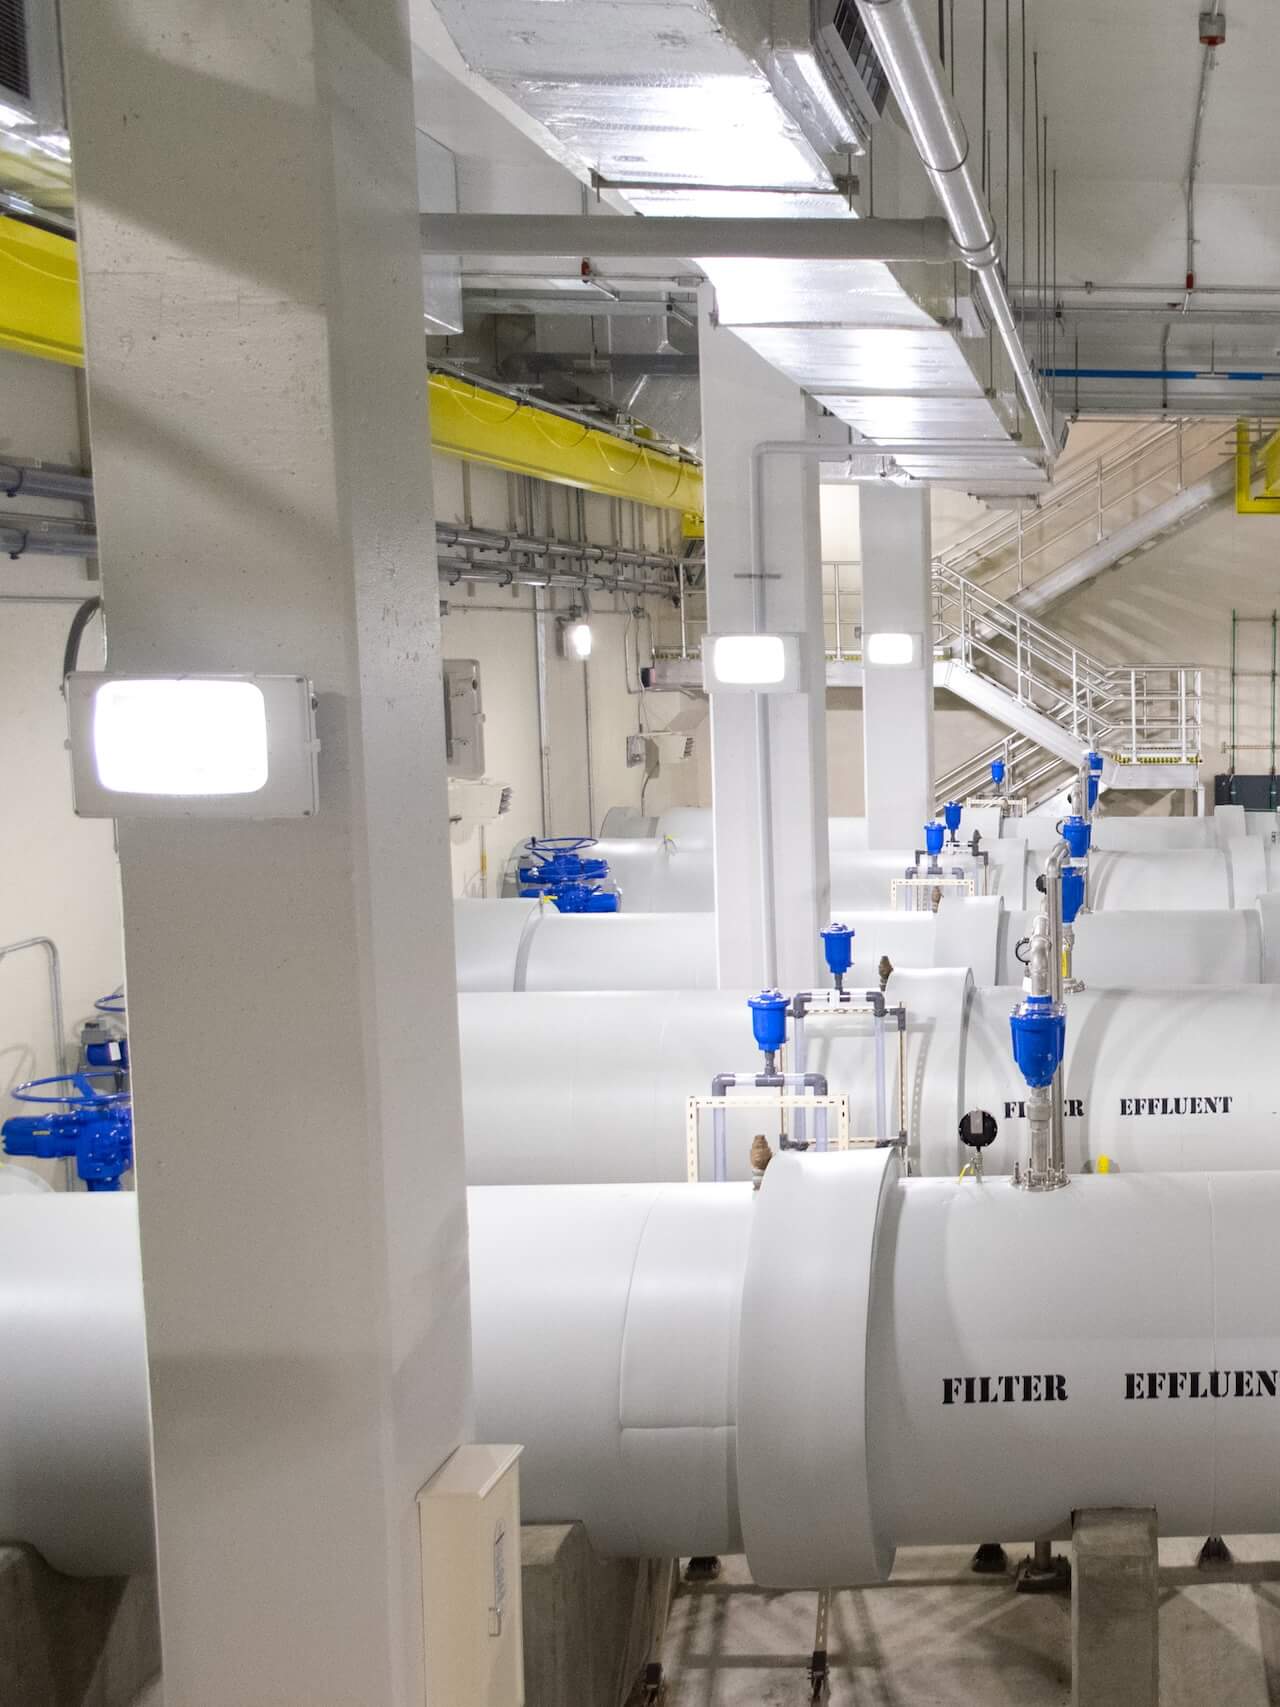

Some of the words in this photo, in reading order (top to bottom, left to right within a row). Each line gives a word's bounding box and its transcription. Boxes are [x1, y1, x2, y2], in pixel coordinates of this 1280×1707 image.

[1004, 1099, 1084, 1119] FIR
[1119, 1096, 1233, 1116] EFFLUENT
[942, 1374, 1069, 1405] FILTER
